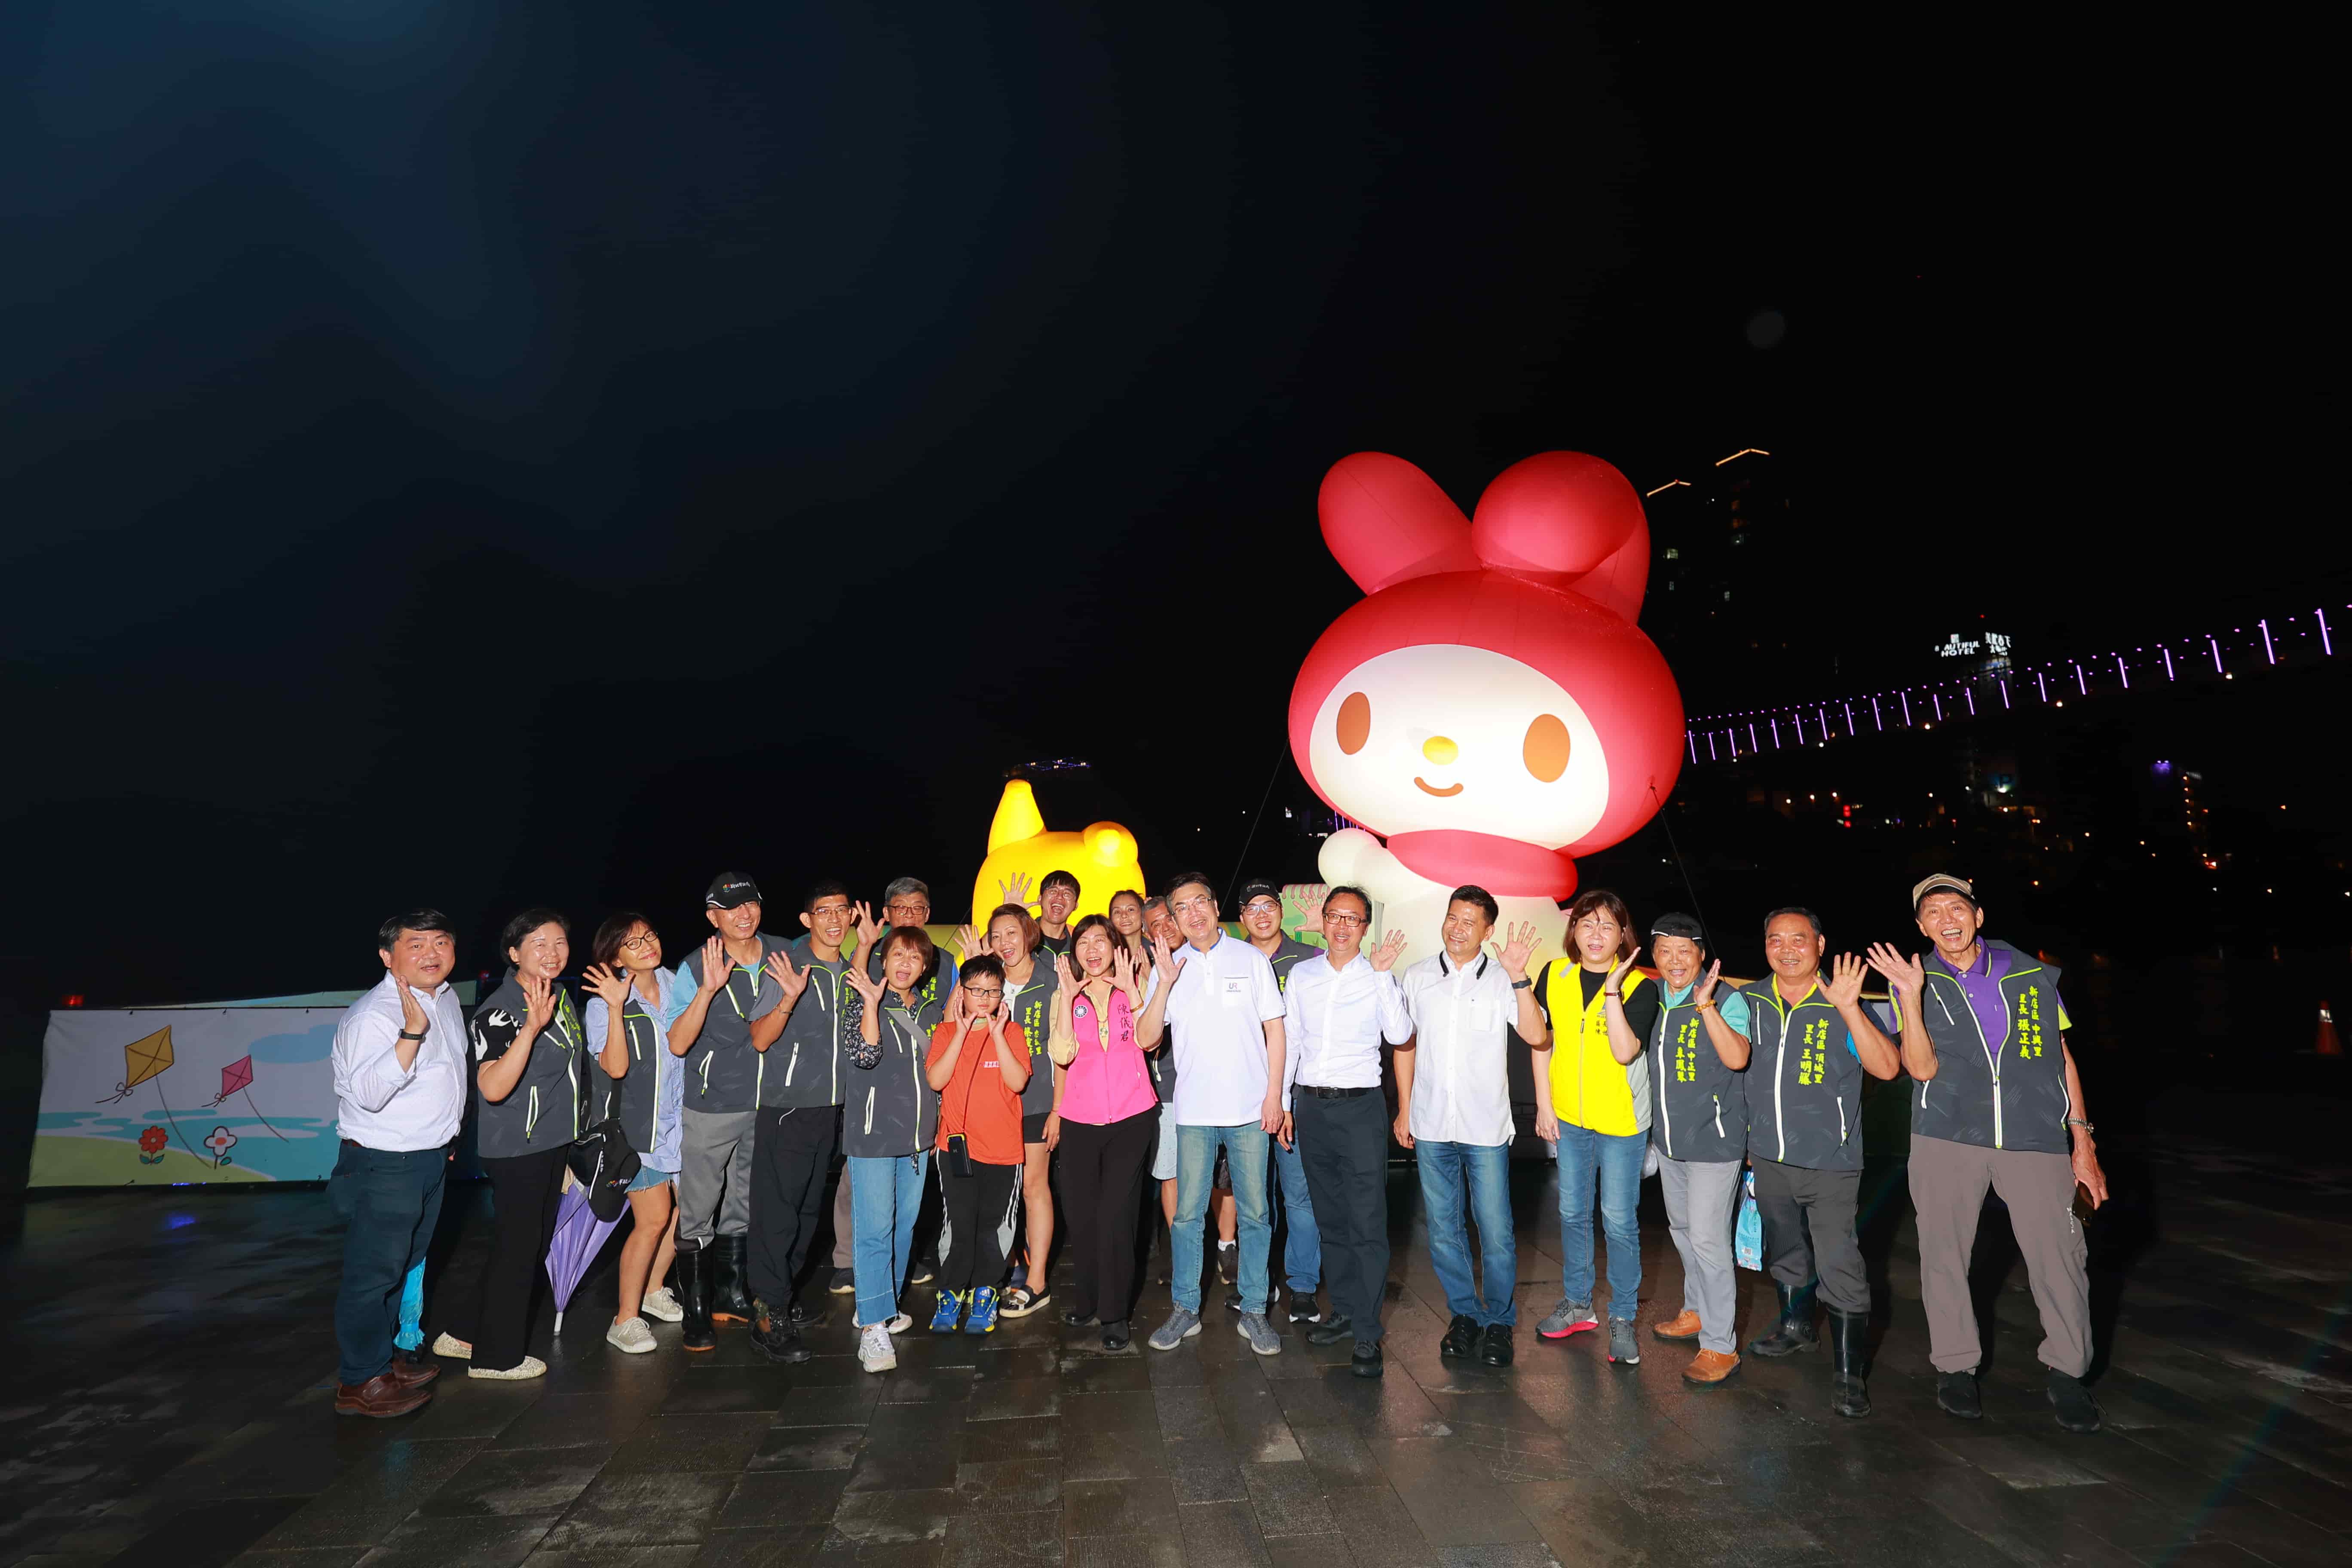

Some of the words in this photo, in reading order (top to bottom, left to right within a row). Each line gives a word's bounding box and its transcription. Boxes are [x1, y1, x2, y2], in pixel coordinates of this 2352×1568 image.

[1935, 640, 1980, 652] BAUTIFUL
[1941, 647, 1975, 657] HOTEL
[2028, 986, 2039, 1020] 新店區
[1687, 1018, 1700, 1048] 新店區
[1816, 1019, 1829, 1050] 新店區
[2017, 1019, 2031, 1060] 張正義
[2031, 1024, 2043, 1057] 中興里
